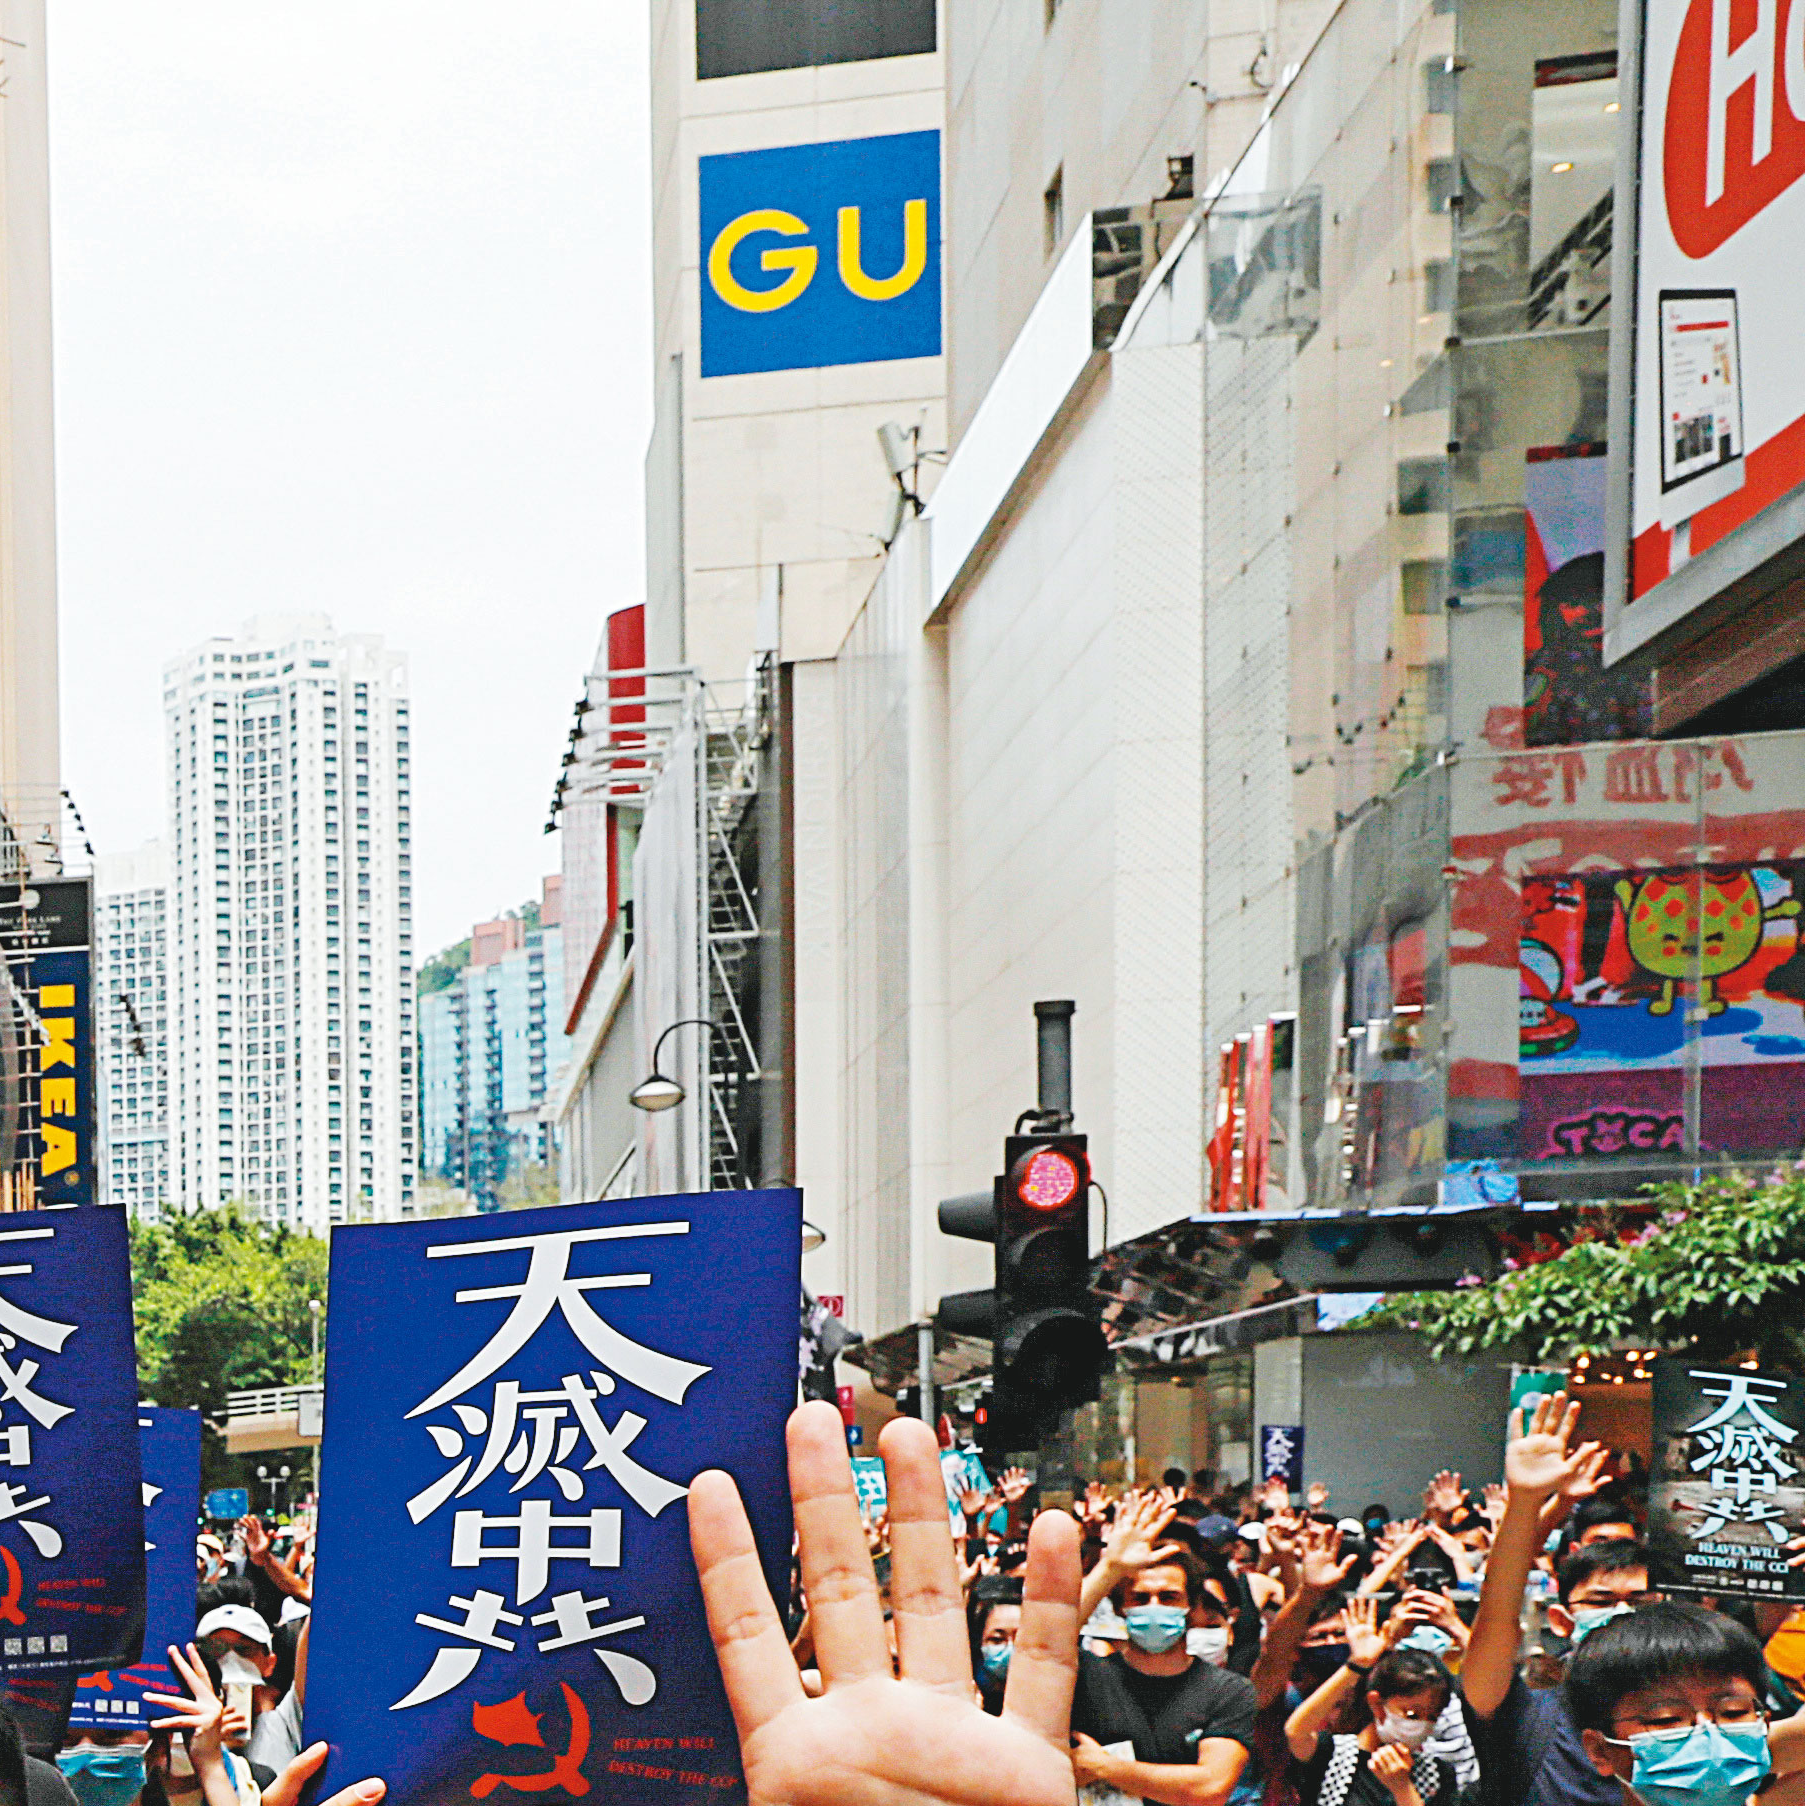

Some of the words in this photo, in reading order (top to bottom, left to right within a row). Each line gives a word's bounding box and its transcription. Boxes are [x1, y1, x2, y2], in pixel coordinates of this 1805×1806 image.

[708, 198, 927, 313] GU
[38, 984, 76, 1178] IKEA
[389, 1221, 713, 1711] 天滅中共
[1686, 1370, 1799, 1543] 天滅中共
[1685, 1554, 1738, 1570] DESTROY
[1742, 1558, 1766, 1572] THE
[1698, 1541, 1747, 1557] HEAVEN
[1750, 1545, 1780, 1559] WILL
